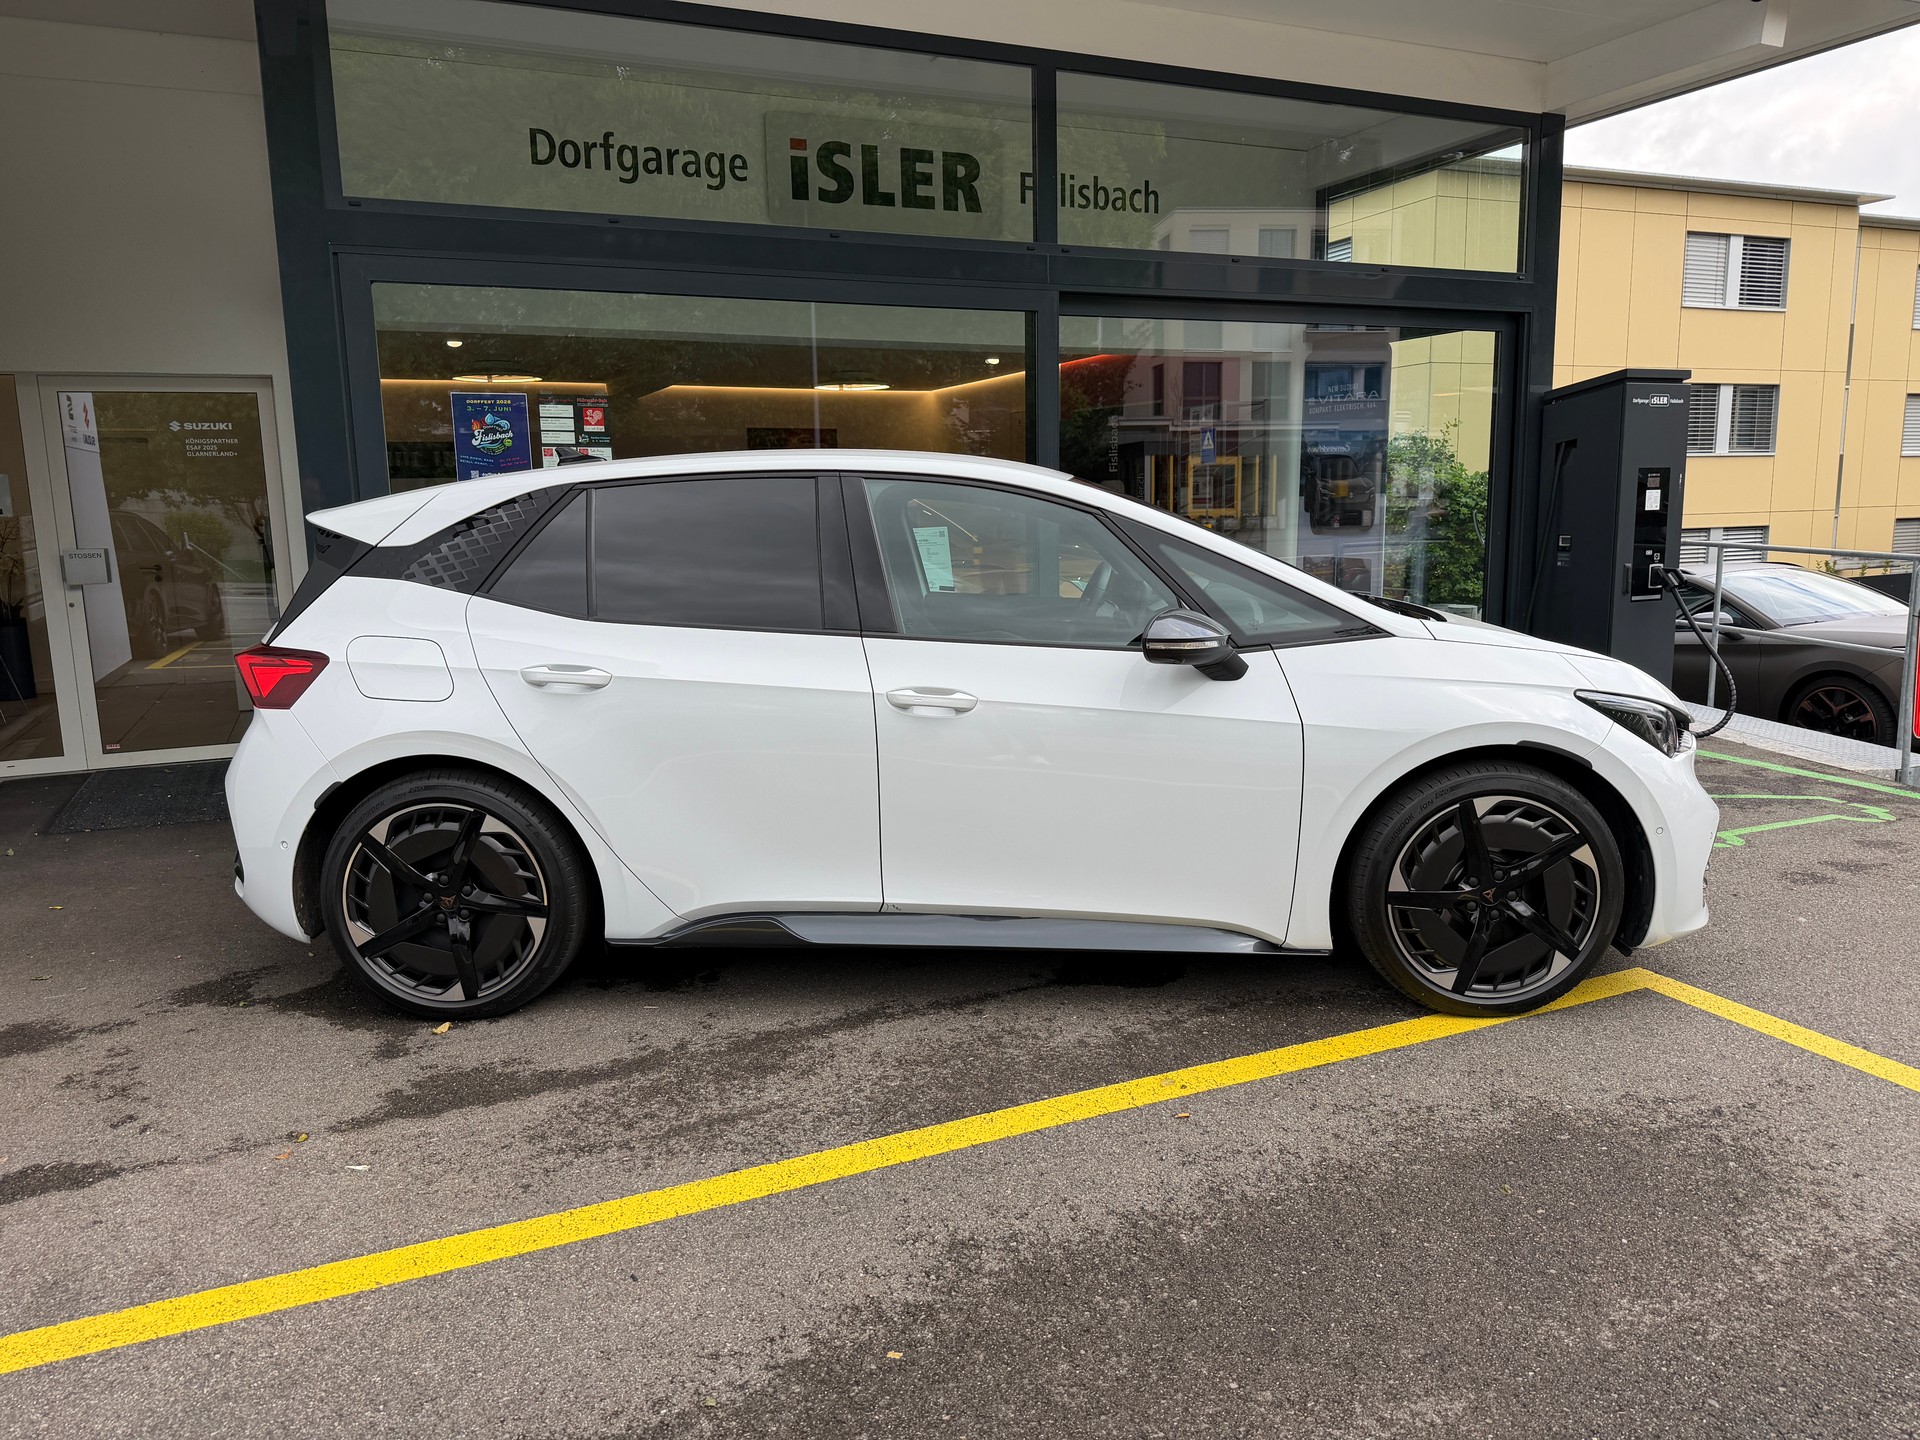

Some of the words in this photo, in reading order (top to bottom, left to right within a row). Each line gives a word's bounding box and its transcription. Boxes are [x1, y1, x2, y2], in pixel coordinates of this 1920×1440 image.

[528, 128, 749, 190] Dorfgarage
[789, 137, 983, 213] iSLER
[1020, 172, 1159, 214] Flisbach
[183, 422, 233, 430] SUZUKI
[472, 430, 513, 446] Fislisbach
